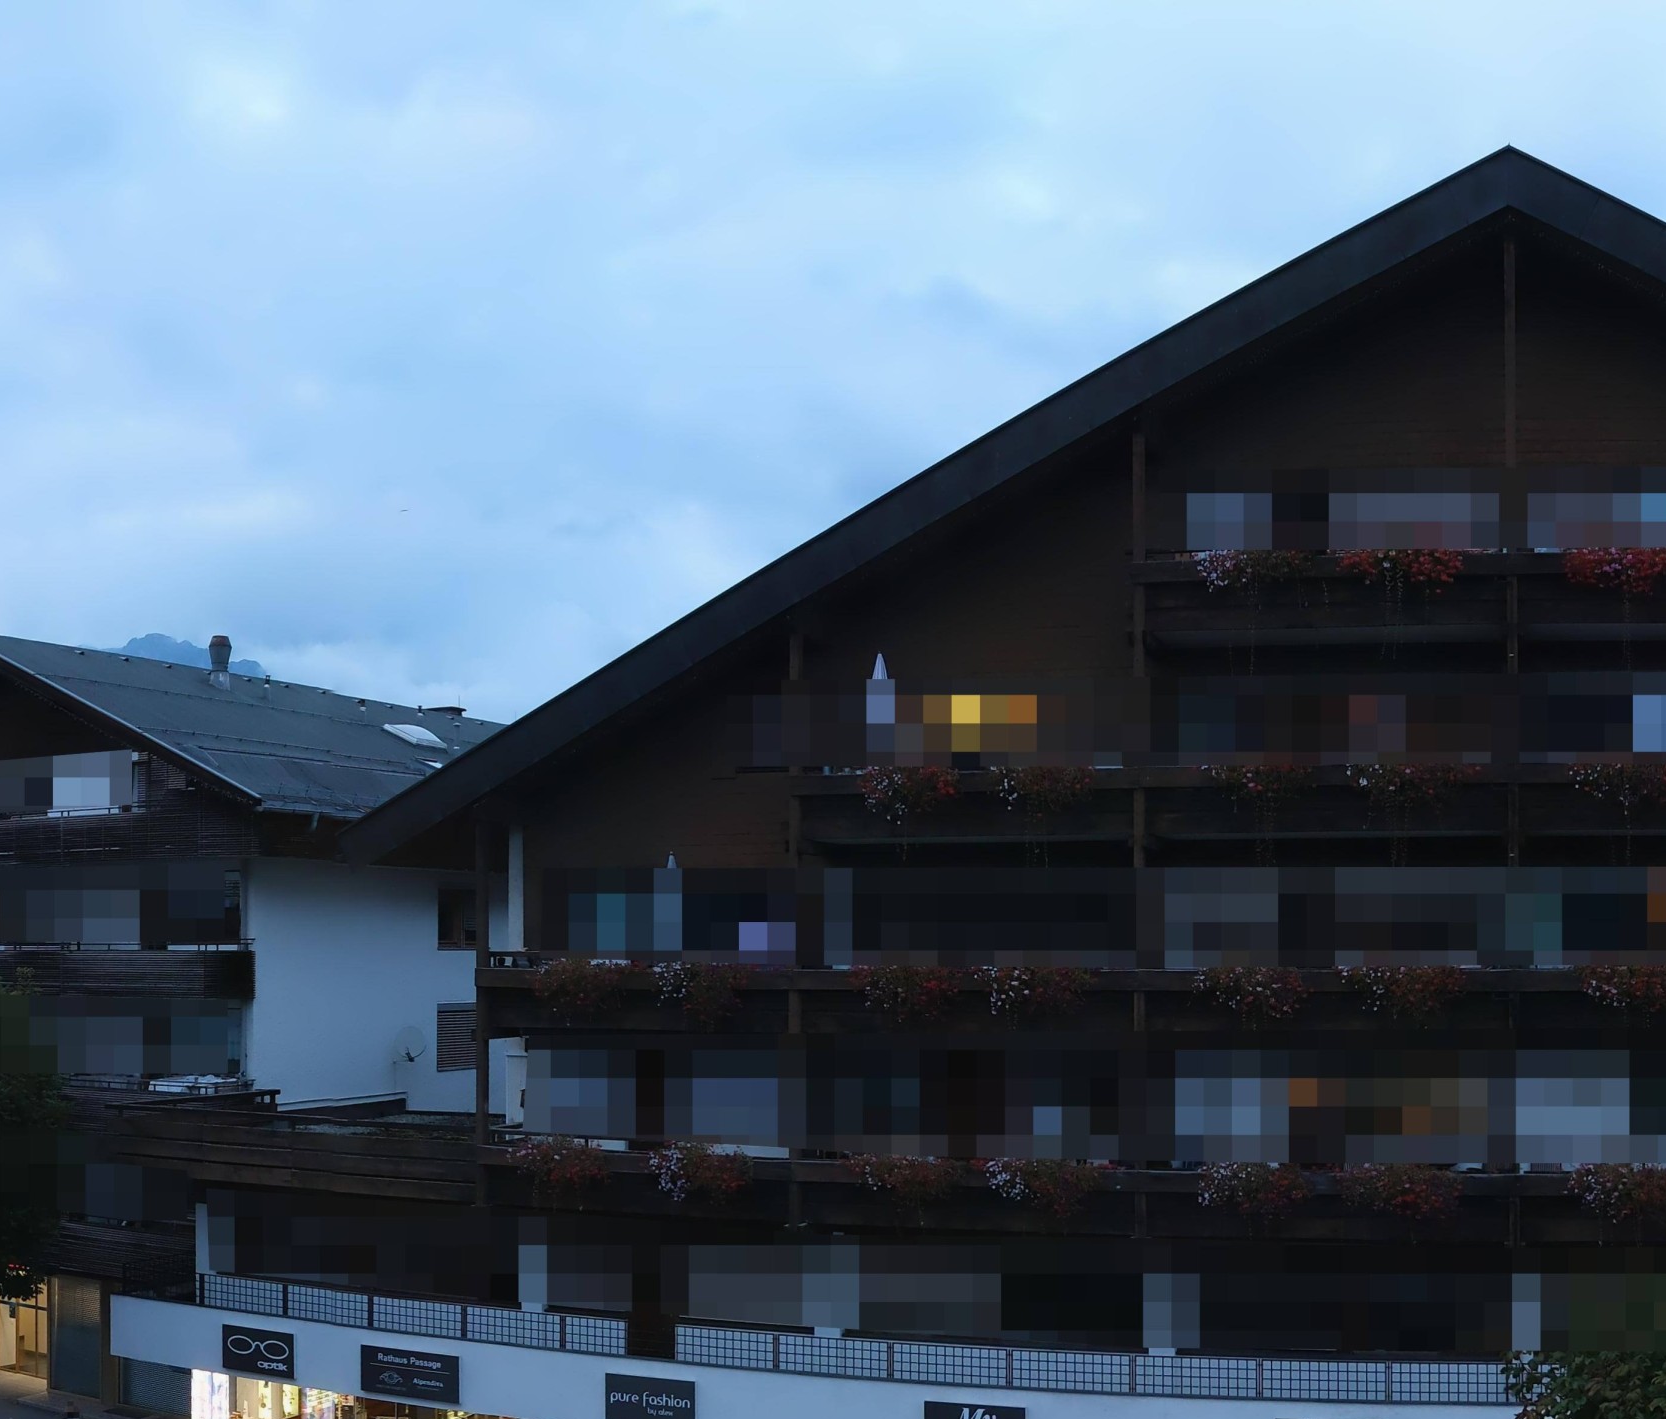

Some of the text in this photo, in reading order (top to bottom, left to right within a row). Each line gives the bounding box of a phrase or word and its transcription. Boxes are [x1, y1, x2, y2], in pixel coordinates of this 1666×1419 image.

[257, 1361, 288, 1371] optik
[377, 1353, 441, 1369] Rathaus Passage
[610, 1391, 690, 1408] pure fashion
[647, 1407, 657, 1416] by
